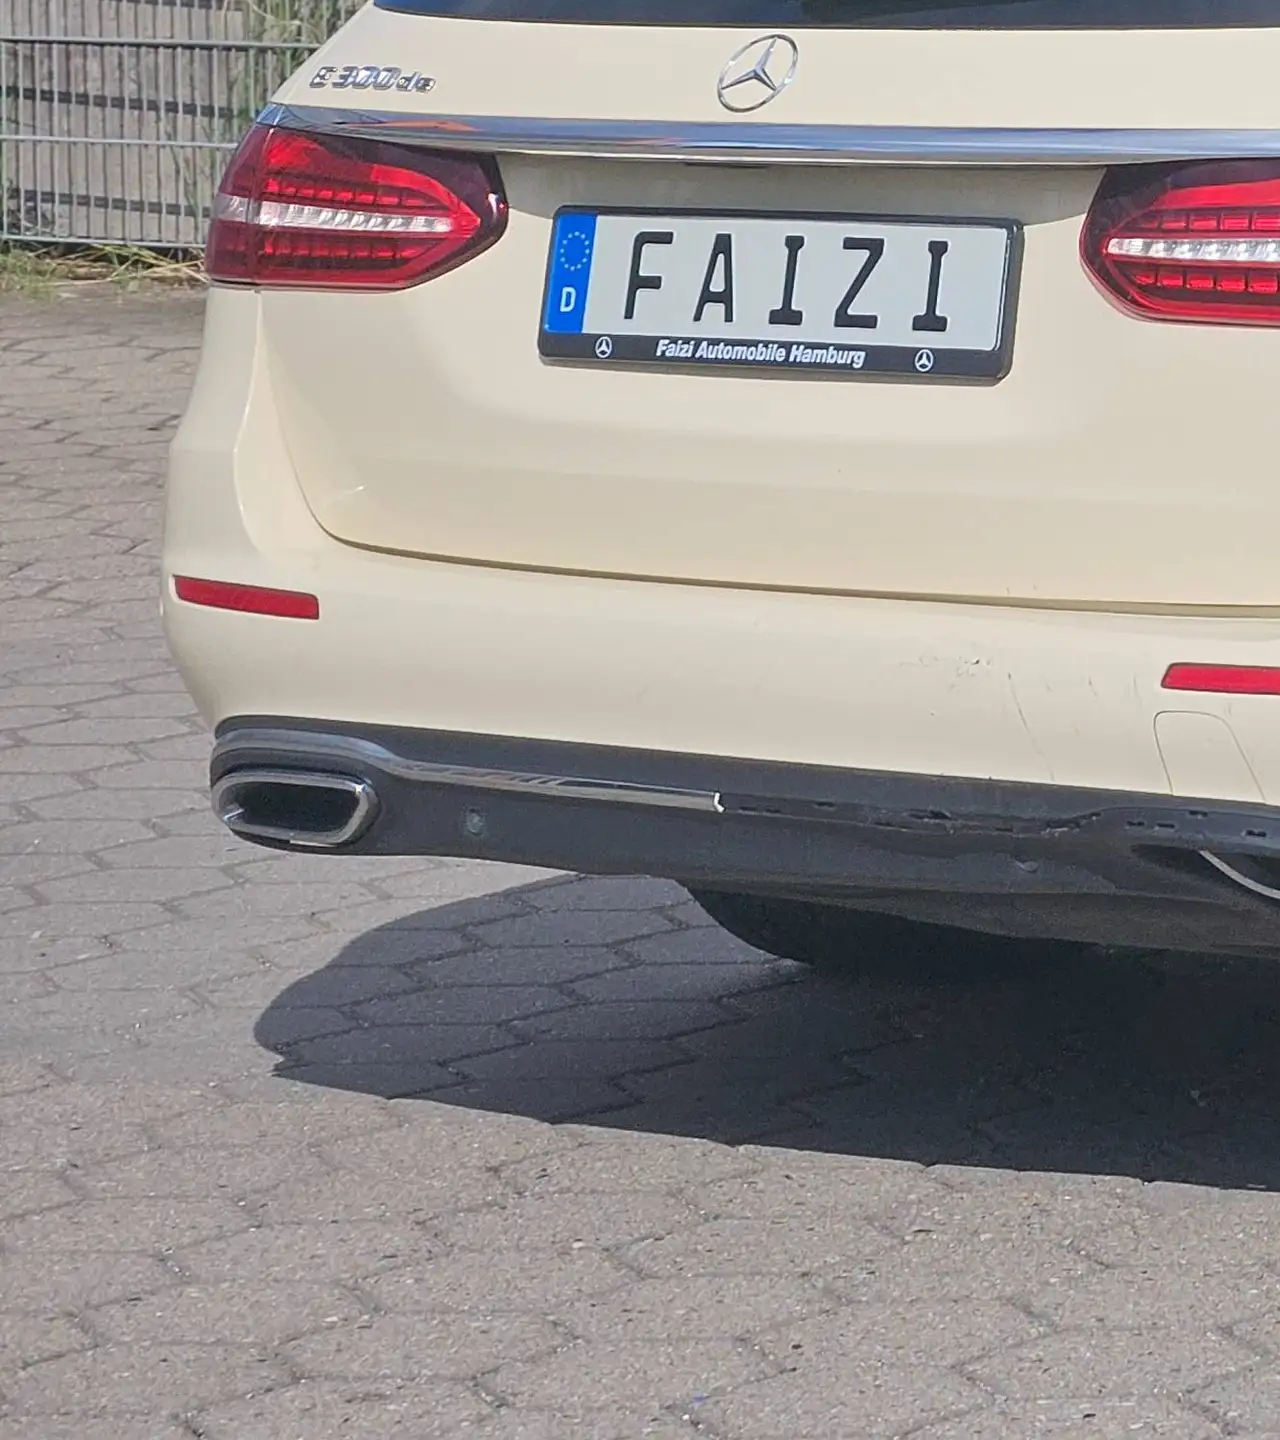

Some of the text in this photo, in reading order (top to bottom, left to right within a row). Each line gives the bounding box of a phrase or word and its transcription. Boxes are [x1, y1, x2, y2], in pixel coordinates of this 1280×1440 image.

[623, 231, 949, 333] FAIZI
[559, 286, 577, 313] D
[655, 339, 867, 369] Faizi Automobile Hamburg
